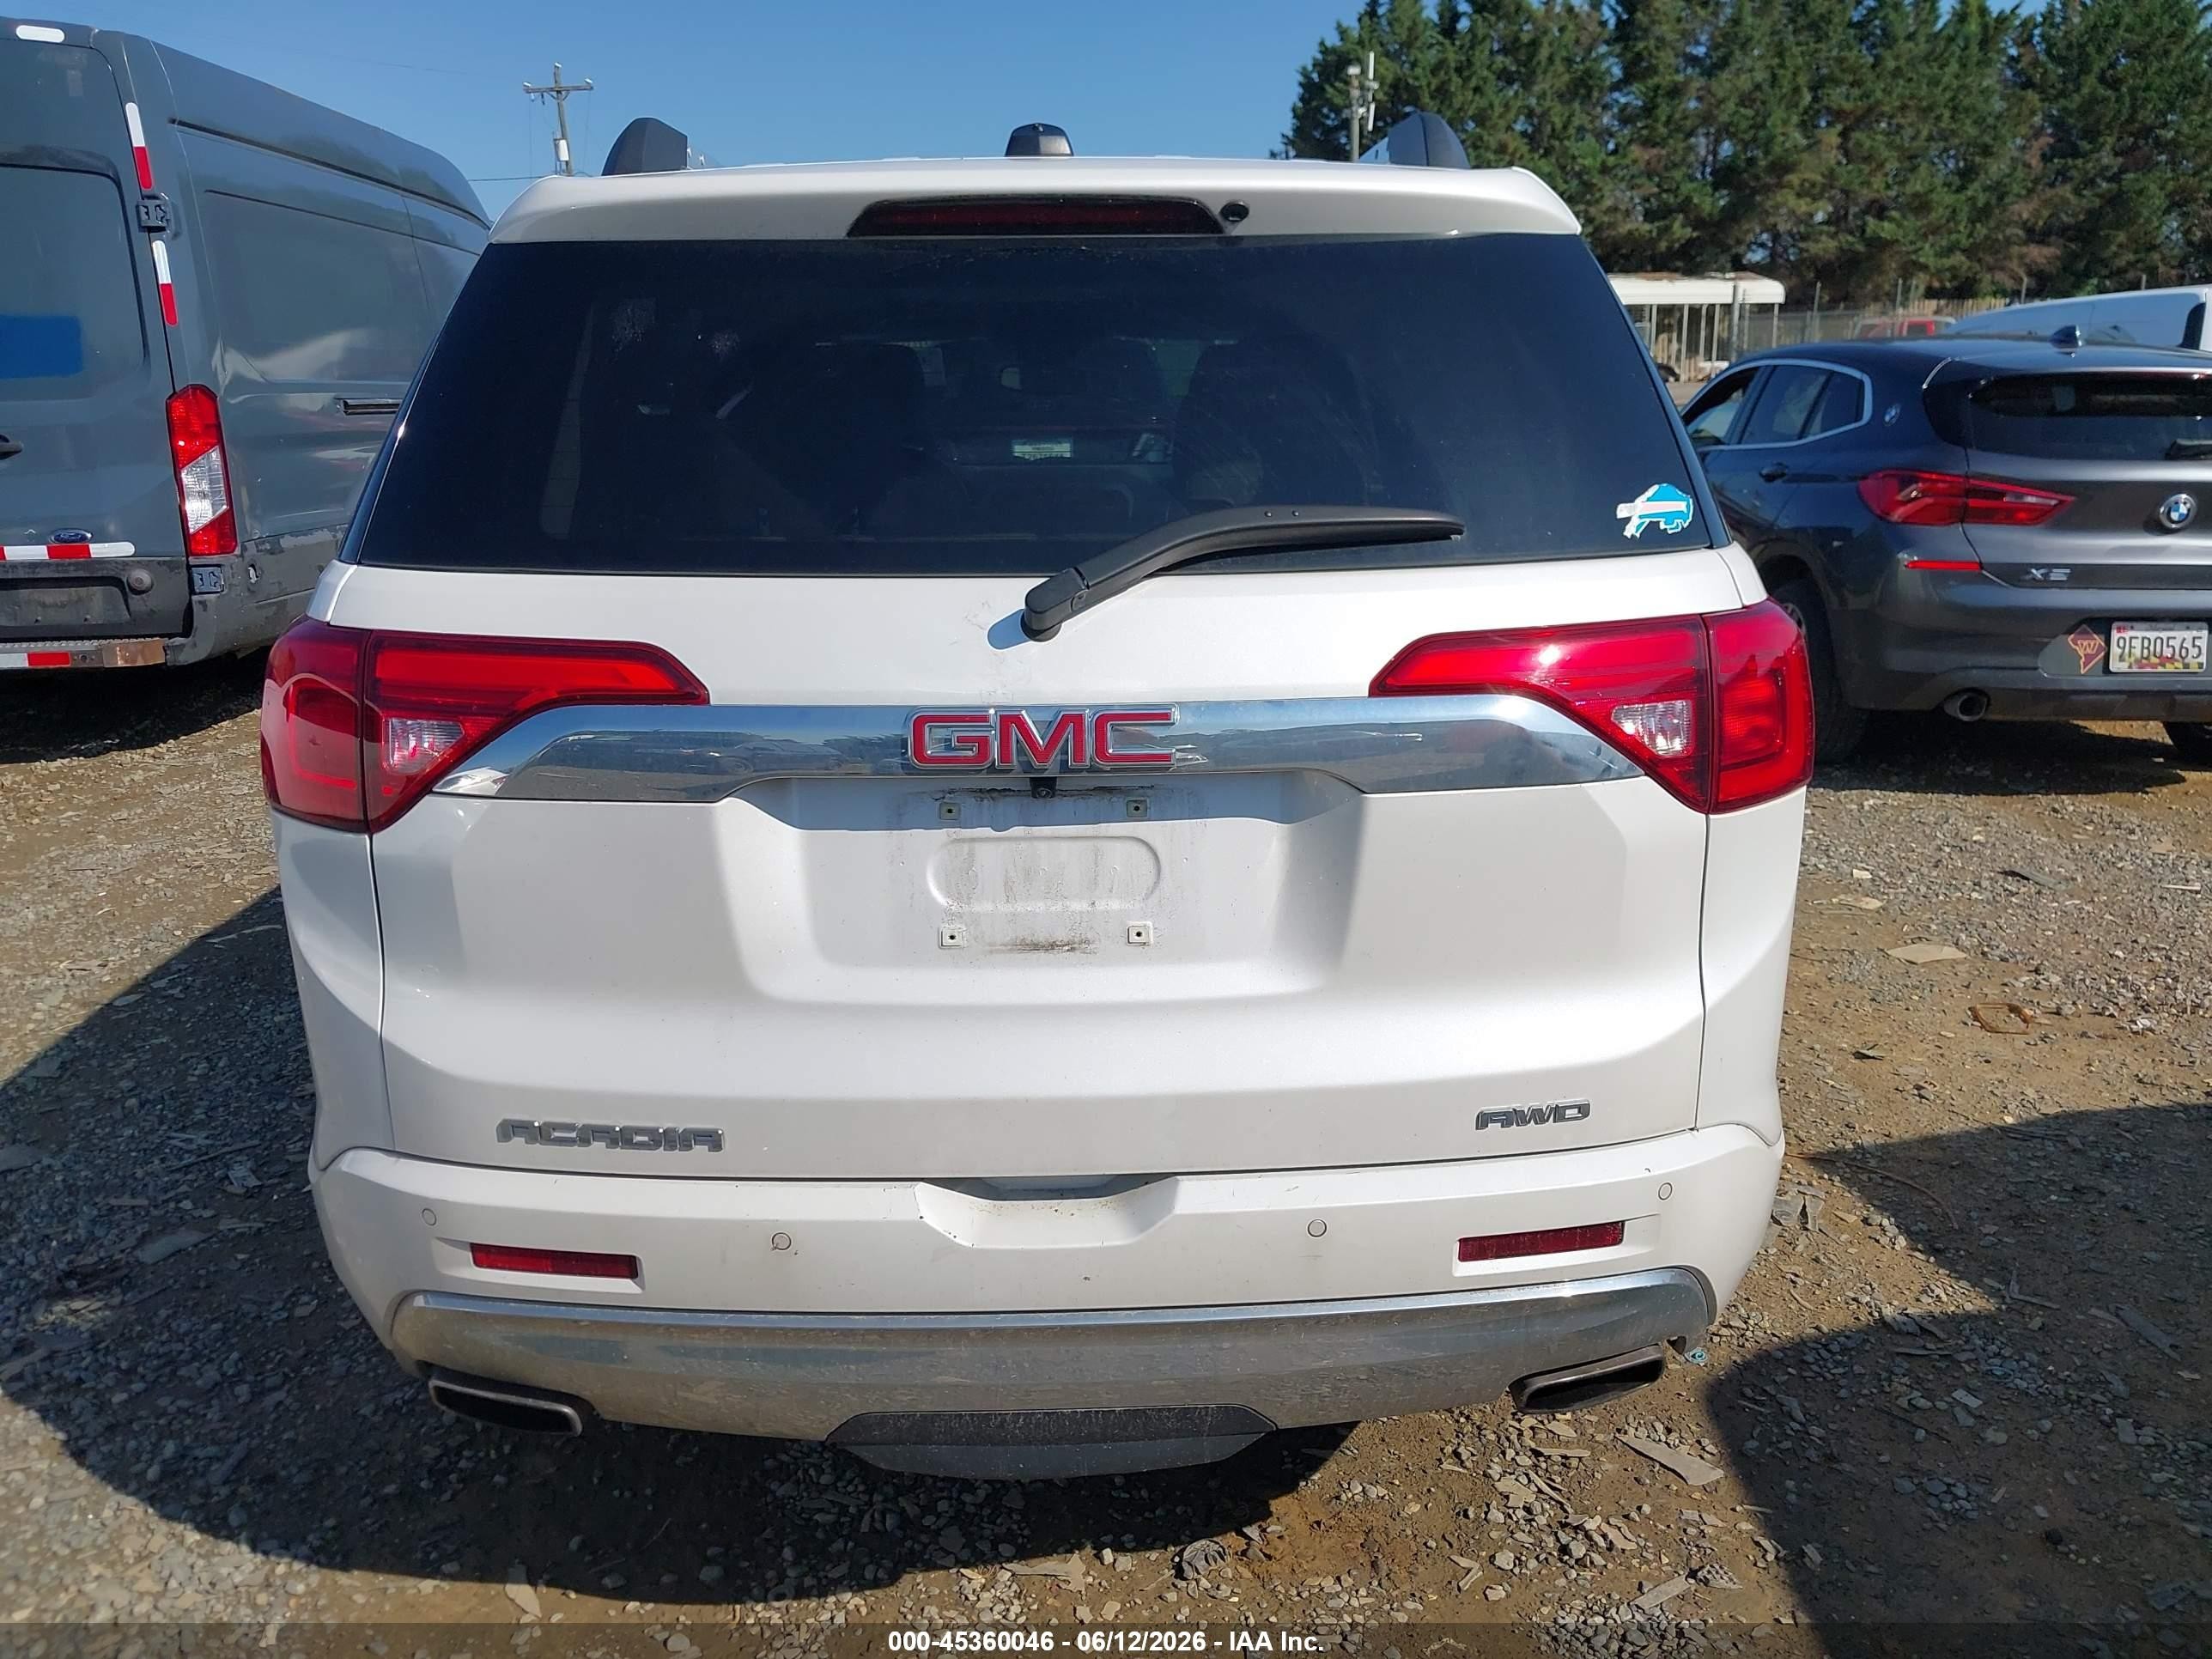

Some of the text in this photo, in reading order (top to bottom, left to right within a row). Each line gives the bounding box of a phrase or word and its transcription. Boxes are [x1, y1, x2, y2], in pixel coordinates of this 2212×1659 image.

[2116, 635, 2203, 661] 9FB0565
[908, 706, 1181, 769] GMC
[1474, 1099, 1591, 1131] AWD
[495, 1117, 724, 1153] ACADIA
